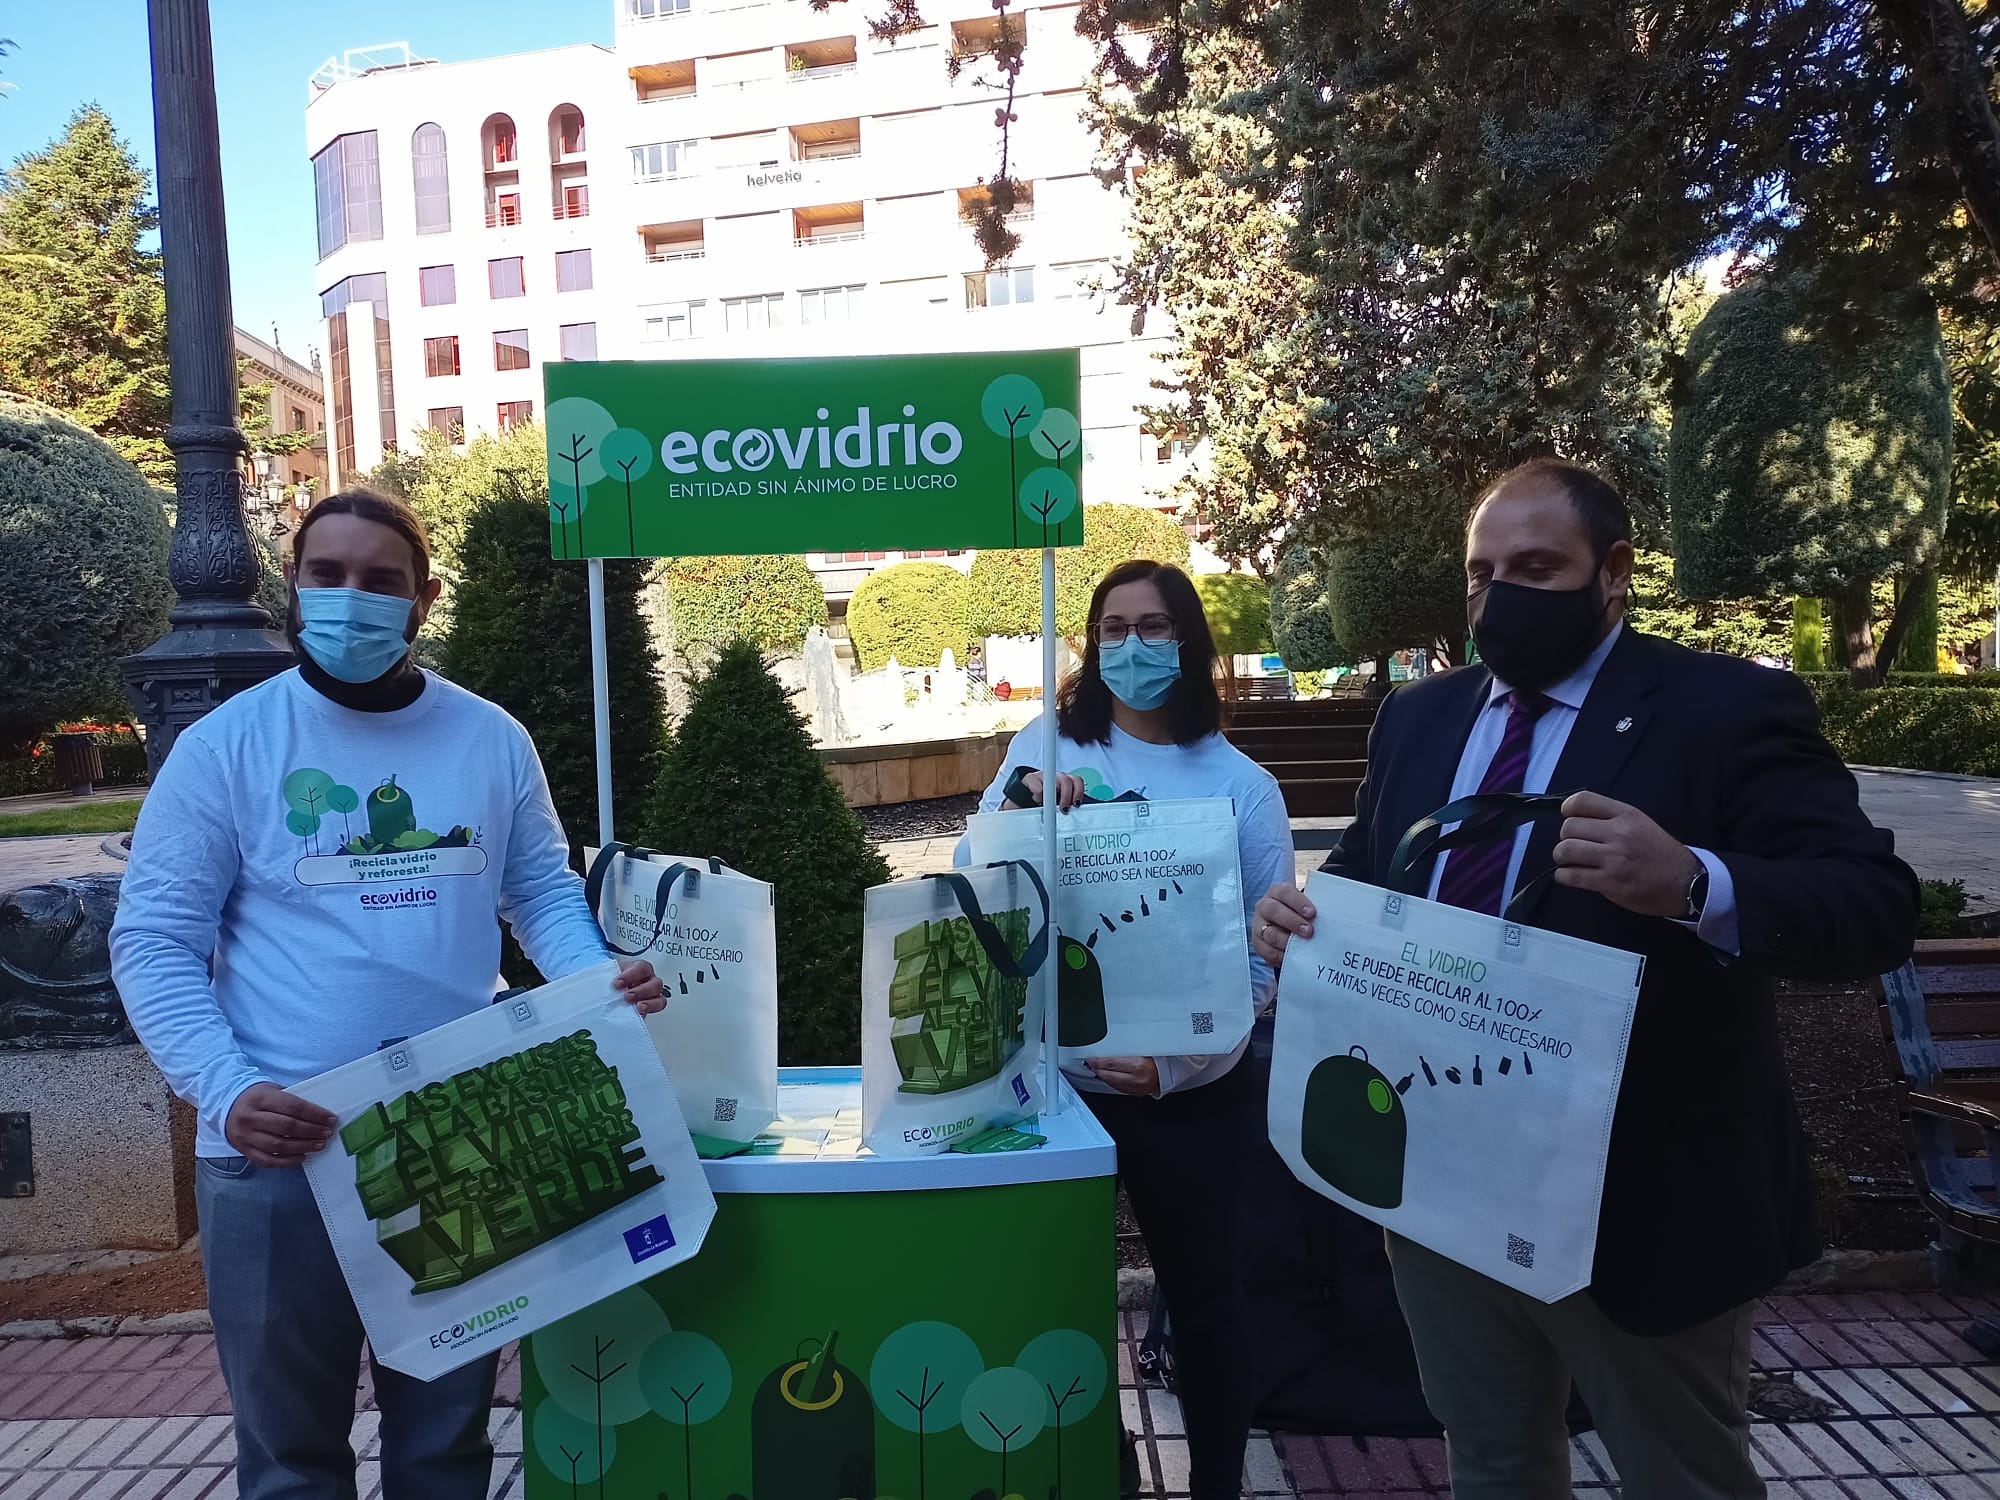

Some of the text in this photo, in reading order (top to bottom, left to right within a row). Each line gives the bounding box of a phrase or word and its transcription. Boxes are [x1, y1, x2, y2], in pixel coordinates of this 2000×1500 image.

[747, 169, 802, 187] helvetia
[660, 404, 963, 474] ecovidrio
[669, 474, 957, 498] ENTIDAD SIN ÁNIMO DE LUCRO
[1064, 833, 1132, 852] EL VIDRIO
[349, 851, 437, 868] ¡Recicla vidrio
[358, 864, 430, 880] y reforesta!
[1075, 852, 1125, 868] RECICLAR
[1129, 851, 1142, 863] AL
[1086, 871, 1118, 883] COMO
[1121, 868, 1142, 881] SEA
[1145, 864, 1204, 879] NECESARIO
[360, 886, 437, 904] ecovidrio
[673, 926, 685, 939] AL
[924, 916, 971, 947] LAS
[666, 942, 683, 957] SEA
[685, 946, 744, 963] NECESARIO
[1401, 941, 1487, 983] EL VIDRIO
[1342, 951, 1543, 1022] SE PUEDE RECICLAR AL 100%
[1317, 964, 1572, 1058] Y TANTAS VECES COMO SEA NECESARIO
[375, 1028, 598, 1131] LAS EXCUSAS
[396, 1077, 627, 1200] EL VIDRIO
[903, 1116, 975, 1143] ECOVIDRIO
[460, 1108, 635, 1200] CONTENEDOR
[430, 1138, 660, 1262] VERDE
[429, 1295, 529, 1349] ECOVIDRIO
